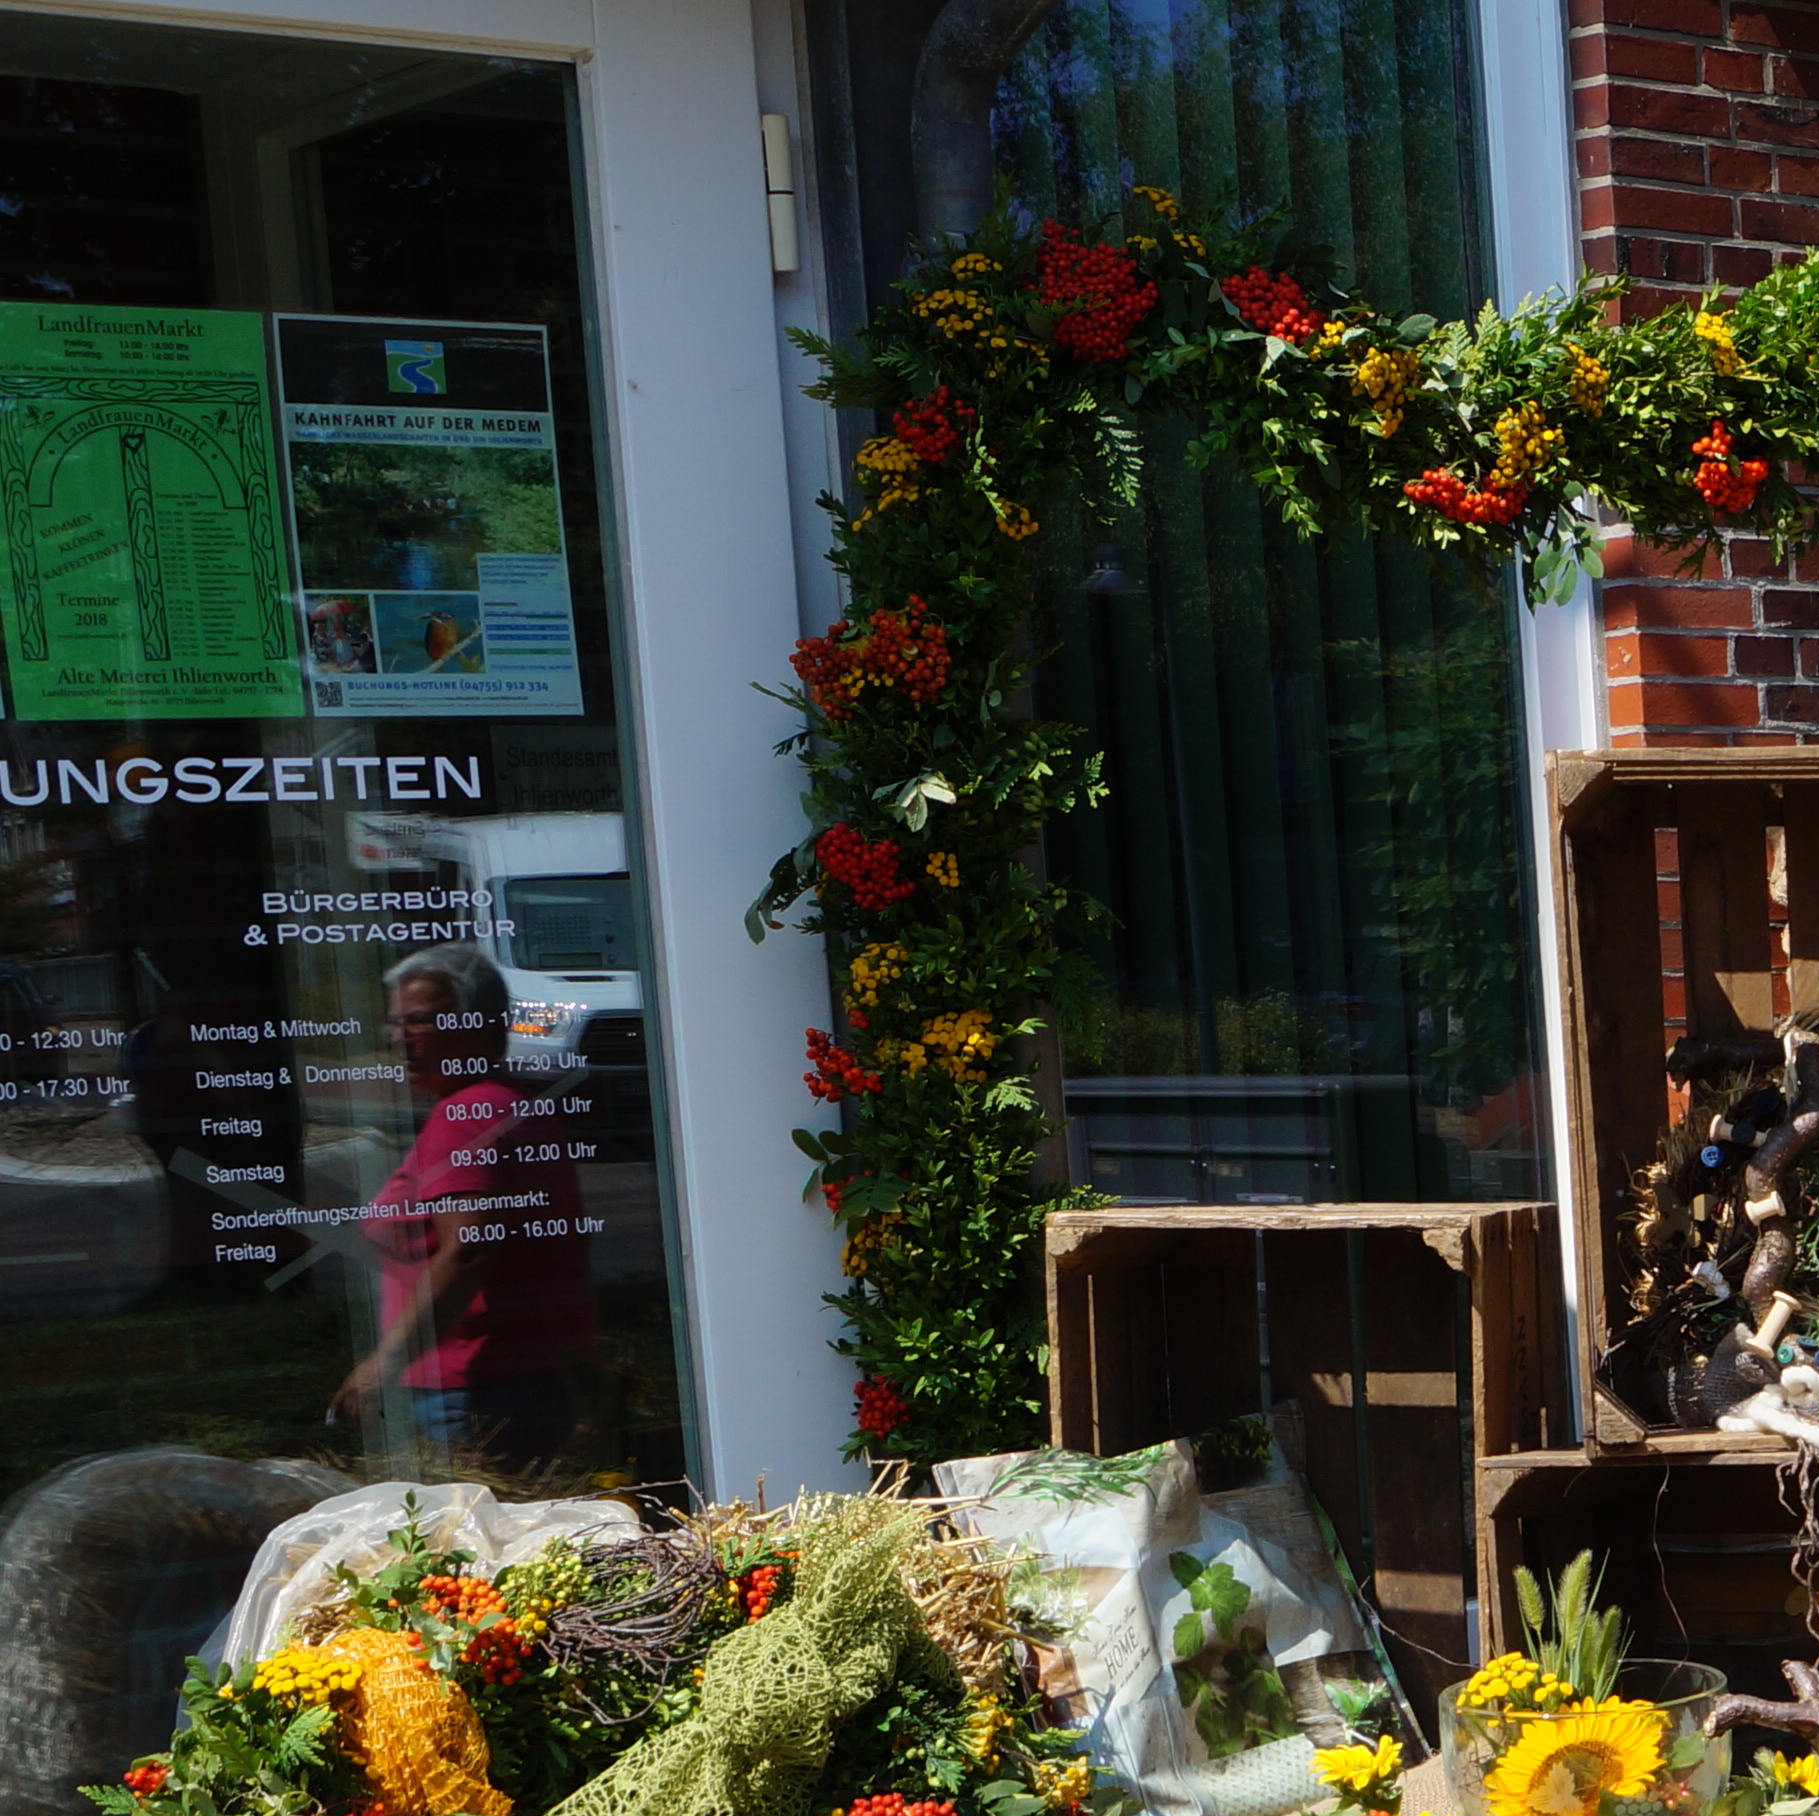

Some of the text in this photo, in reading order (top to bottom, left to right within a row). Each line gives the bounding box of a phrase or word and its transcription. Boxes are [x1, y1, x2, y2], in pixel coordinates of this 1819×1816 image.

[37, 315, 204, 337] LandfrauenMarkt
[57, 410, 208, 450] LandfrauenMarkt
[294, 412, 542, 432] KAHNFAHRT AUF DER MEDEM
[40, 512, 93, 539] KOMMEN
[56, 592, 121, 607] Termine
[74, 613, 108, 626] 2018
[57, 666, 277, 684] Alte Meierei Ihlienworth
[347, 679, 549, 692] BUCHUNGS-HOTLINE (04755) 912 334
[507, 746, 619, 768] Standesamt
[0, 756, 481, 806] UNGSZEITEN
[243, 924, 268, 946] &
[190, 1017, 361, 1044] Montag & Mittwoch
[436, 1011, 483, 1031] 08.00
[31, 1029, 83, 1049] 12.30
[90, 1028, 124, 1047] Uhr
[441, 1057, 488, 1076] 08.00
[505, 1051, 551, 1071] 17.30
[555, 1047, 588, 1068] Uhr
[37, 1078, 88, 1098] 17.30
[96, 1076, 130, 1096] Uhr
[195, 1063, 405, 1090] Dienstag & Donnerstag
[446, 1102, 493, 1121] 08.00
[510, 1098, 555, 1117] 12.00
[562, 1096, 592, 1114] Uhr
[201, 1117, 263, 1138] Freitag
[450, 1148, 498, 1167] 09.30
[514, 1143, 560, 1163] 12.00
[567, 1141, 597, 1159] Uhr
[206, 1164, 285, 1184] Samstag
[211, 1190, 550, 1230] Sonderöffnungszeiten Landfrauenmarkt:
[458, 1223, 506, 1243] 08.00
[522, 1218, 568, 1238] 16.00
[575, 1216, 605, 1234] Uhr
[215, 1243, 276, 1263] Freitag
[1103, 1625, 1139, 1680] HOME
